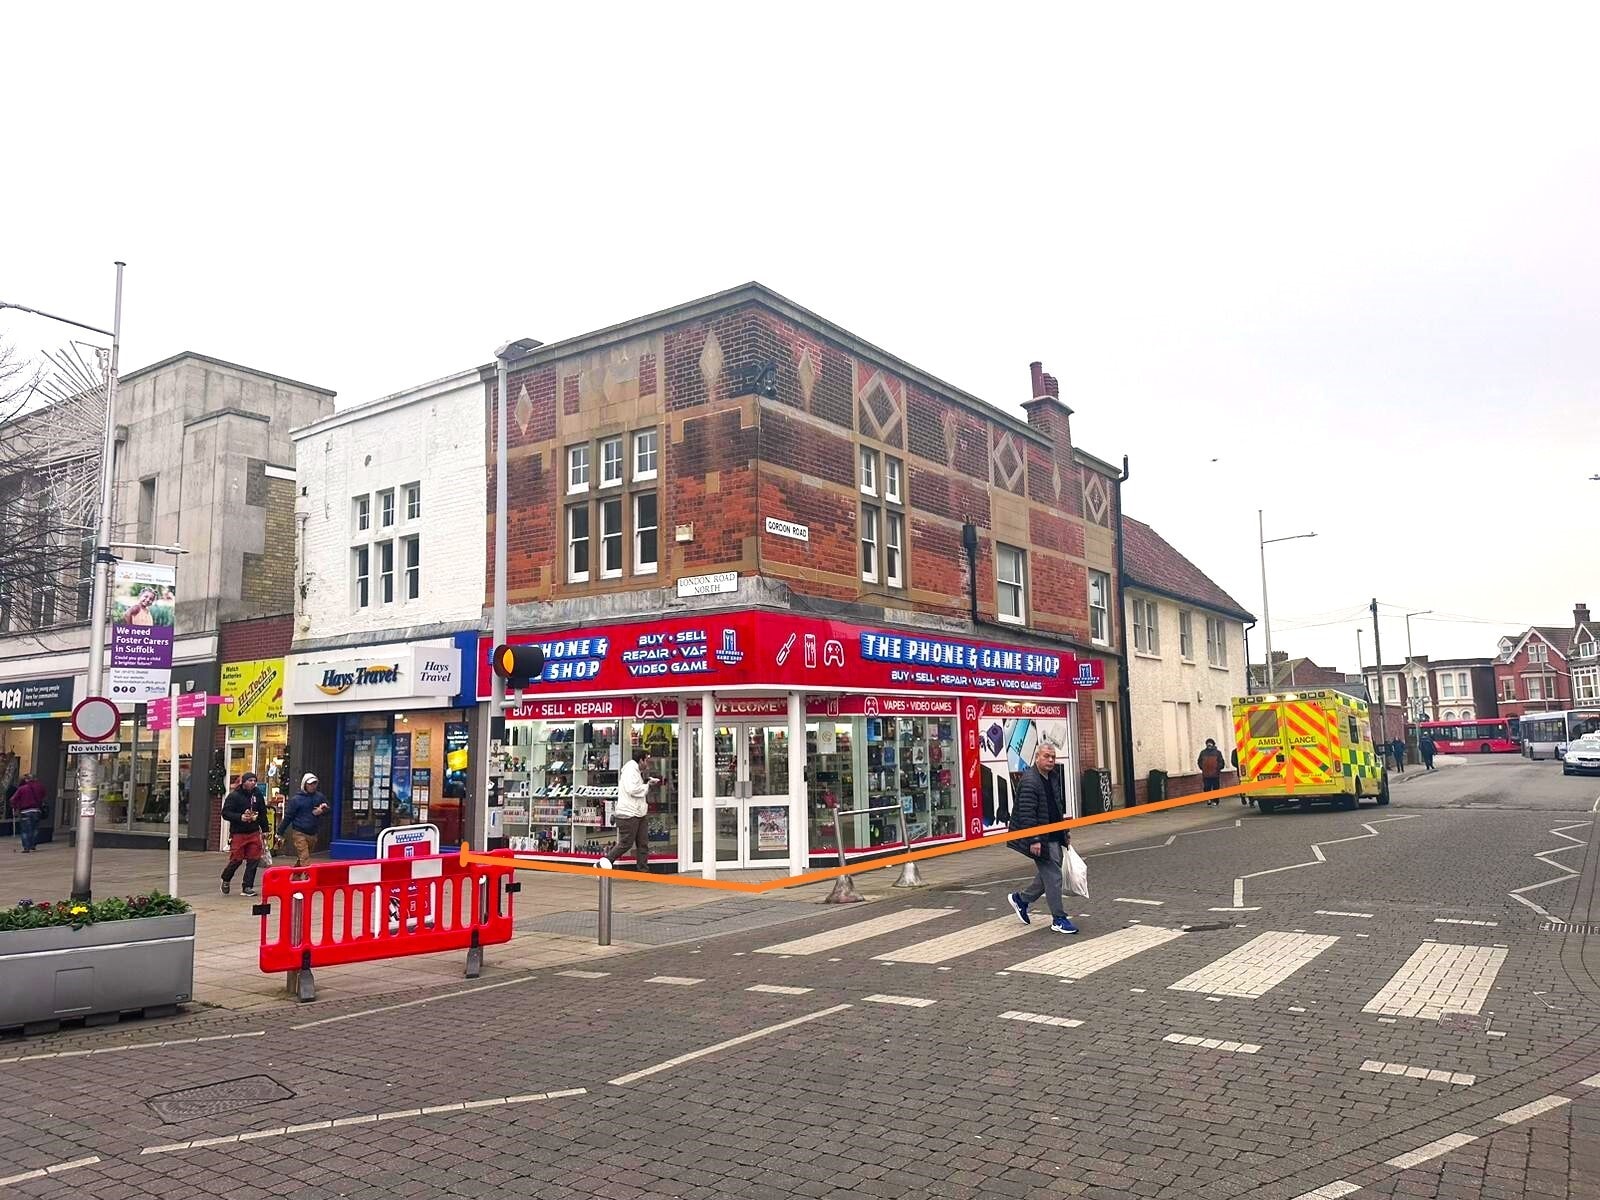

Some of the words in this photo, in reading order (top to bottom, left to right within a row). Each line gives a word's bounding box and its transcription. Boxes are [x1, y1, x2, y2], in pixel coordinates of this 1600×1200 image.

[768, 521, 791, 534] GORDON
[792, 526, 807, 538] ROAD
[679, 577, 711, 587] LONDON
[713, 573, 736, 583] ROAD
[694, 584, 721, 594] NORTH
[116, 626, 130, 635] We
[131, 628, 151, 636] need
[116, 636, 142, 644] Foster
[143, 637, 169, 646] Carers
[639, 634, 666, 646] BUY
[676, 630, 707, 642] SELL
[115, 645, 124, 653] in
[125, 645, 155, 654] Suffolk
[539, 639, 591, 658] HONE
[597, 638, 608, 656] &
[864, 634, 902, 658] THE
[907, 640, 964, 665] PHONE
[969, 648, 978, 669] &
[983, 649, 1022, 671] GAME
[1026, 654, 1060, 674] SHOP
[622, 648, 669, 661] REPAIR
[424, 661, 449, 672] Hays
[550, 660, 600, 679] SHOP
[629, 663, 668, 675] VIDEO
[321, 669, 355, 691] Hays
[355, 663, 399, 685] Travel
[420, 671, 452, 682] Travel
[891, 670, 910, 681] BUY
[915, 672, 935, 682] SELL
[940, 674, 968, 685] REPAIR
[972, 677, 996, 687] VAPES
[1000, 679, 1020, 689] VIDEO
[1020, 681, 1042, 690] GAMES
[512, 704, 534, 717] BUY
[541, 703, 566, 716] SELL
[574, 702, 613, 715] REPAIR
[883, 700, 906, 710] VAPES
[909, 701, 930, 711] VIDEO
[930, 701, 952, 712] GAMES
[991, 703, 1016, 714] REPAIRS
[1021, 704, 1061, 715] REPLACEMENTS
[70, 745, 83, 753] No
[85, 744, 118, 752] vehicles
